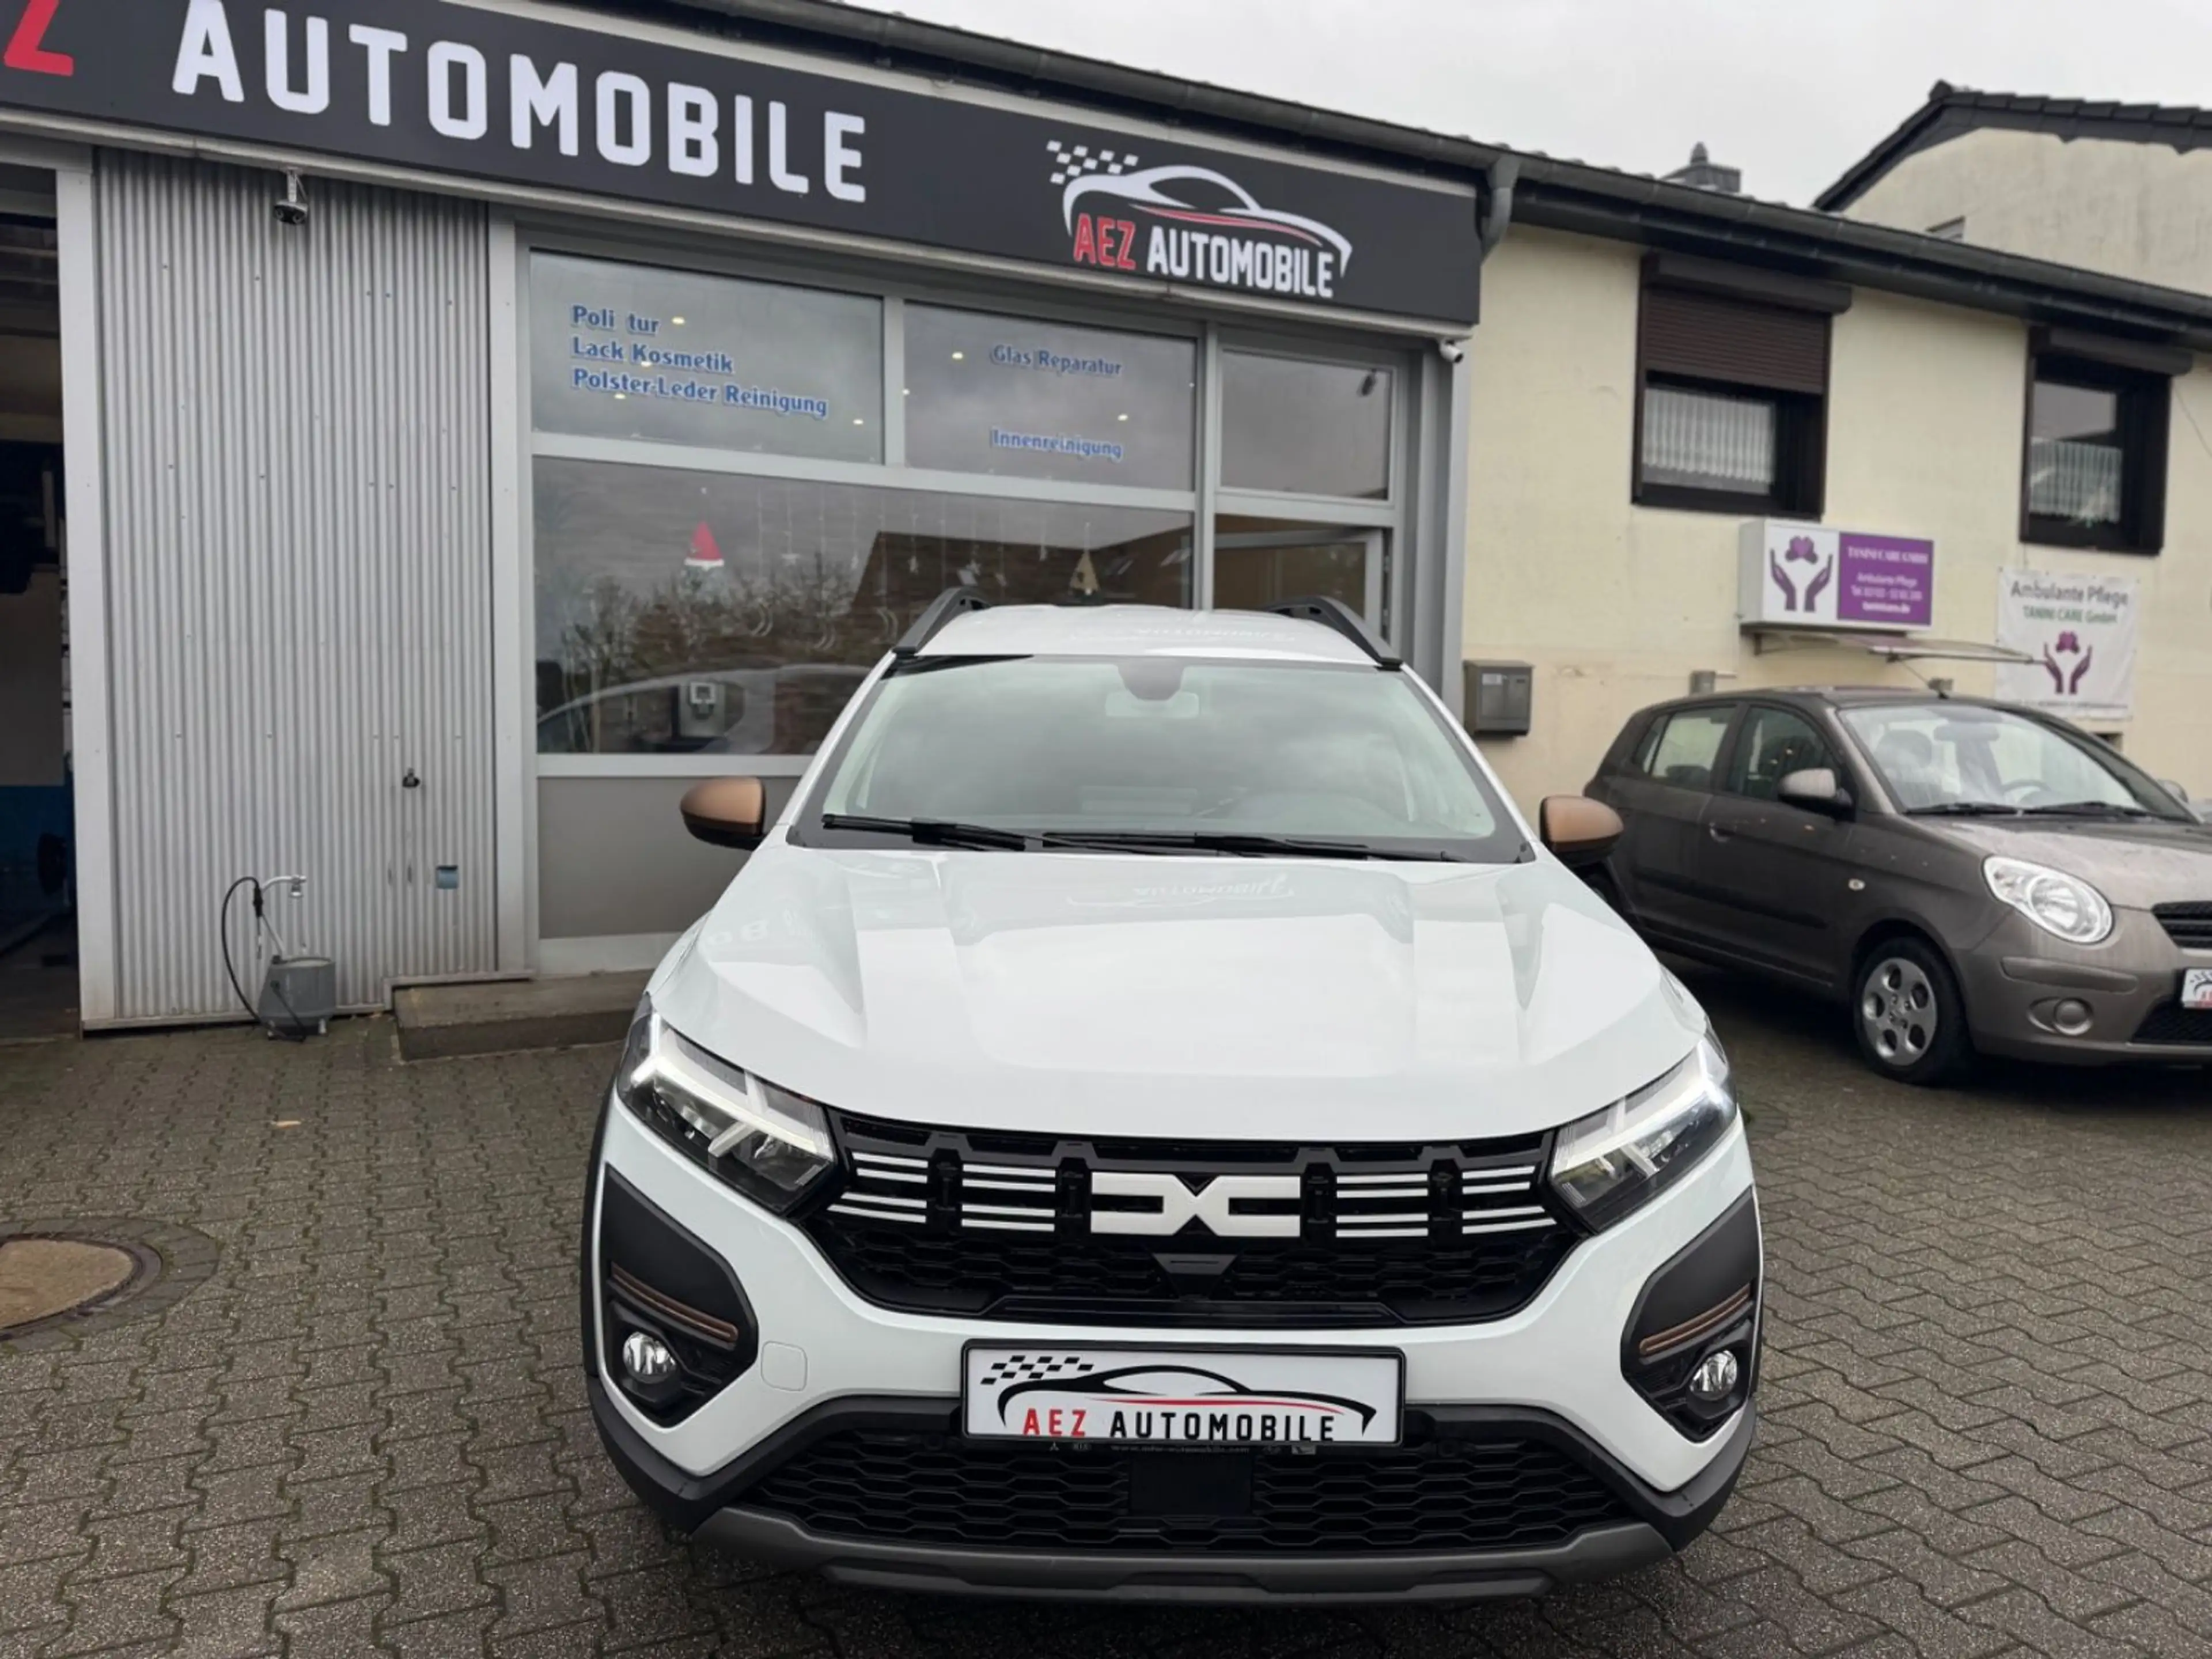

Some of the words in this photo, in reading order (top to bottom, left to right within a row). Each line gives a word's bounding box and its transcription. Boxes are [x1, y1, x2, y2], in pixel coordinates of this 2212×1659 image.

[173, 0, 865, 203] AUTOMOBILE
[1073, 213, 1136, 270] AEZ
[1146, 225, 1334, 298] AUTOMOBILE
[573, 336, 623, 360] Lack
[632, 343, 733, 373] Kosmetik
[993, 344, 1031, 365] Glas
[1037, 349, 1122, 376] Reparatur
[725, 384, 827, 418] Reinigung
[992, 429, 1123, 460] Innenreinigung
[2010, 579, 2084, 602] Ambulante
[2087, 585, 2129, 609] Pflege
[1022, 1408, 1086, 1437] AEZ
[1109, 1411, 1335, 1441] AUTOMOBILE
